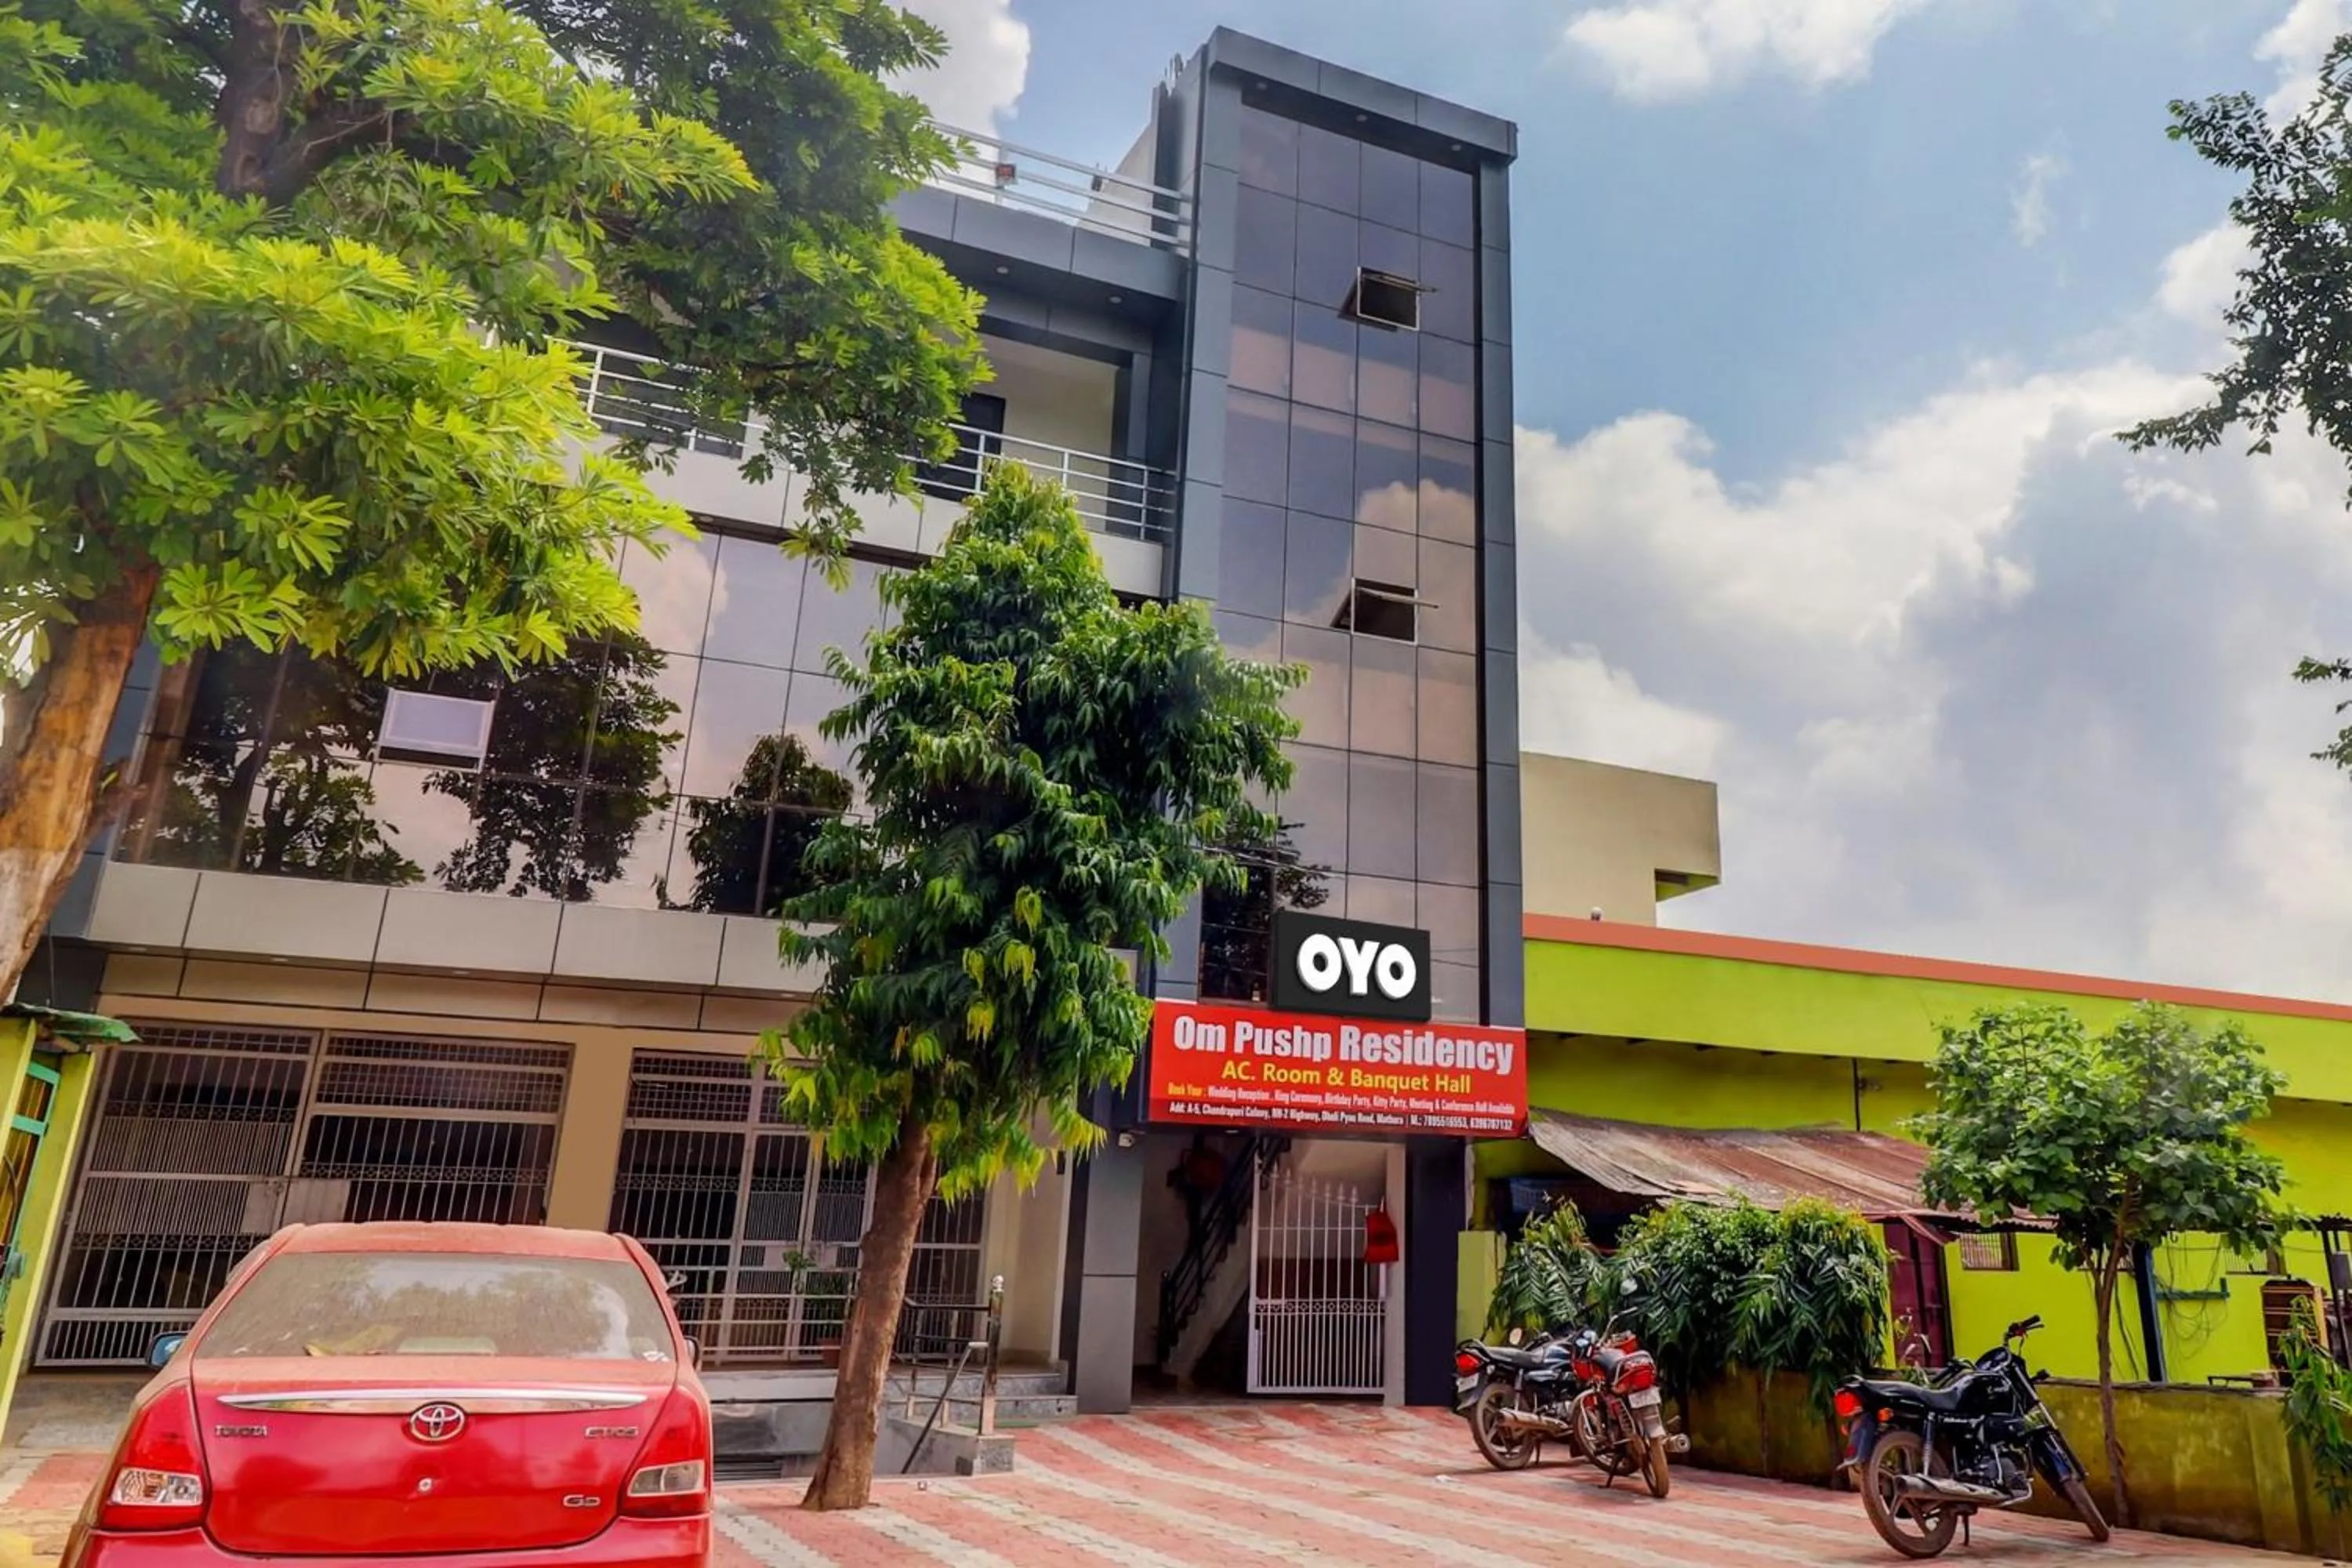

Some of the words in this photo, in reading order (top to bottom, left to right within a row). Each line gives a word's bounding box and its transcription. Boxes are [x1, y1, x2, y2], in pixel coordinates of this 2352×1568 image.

[1297, 934, 1417, 1000] OYO
[1174, 1015, 1225, 1052] Om
[1233, 1020, 1332, 1062] Pushp
[1340, 1025, 1514, 1075] Residency
[1221, 1060, 1254, 1081] AC.
[1262, 1063, 1321, 1085] Room
[1327, 1068, 1345, 1086] &
[1351, 1070, 1428, 1094] Banquet
[1436, 1073, 1472, 1094] Hall
